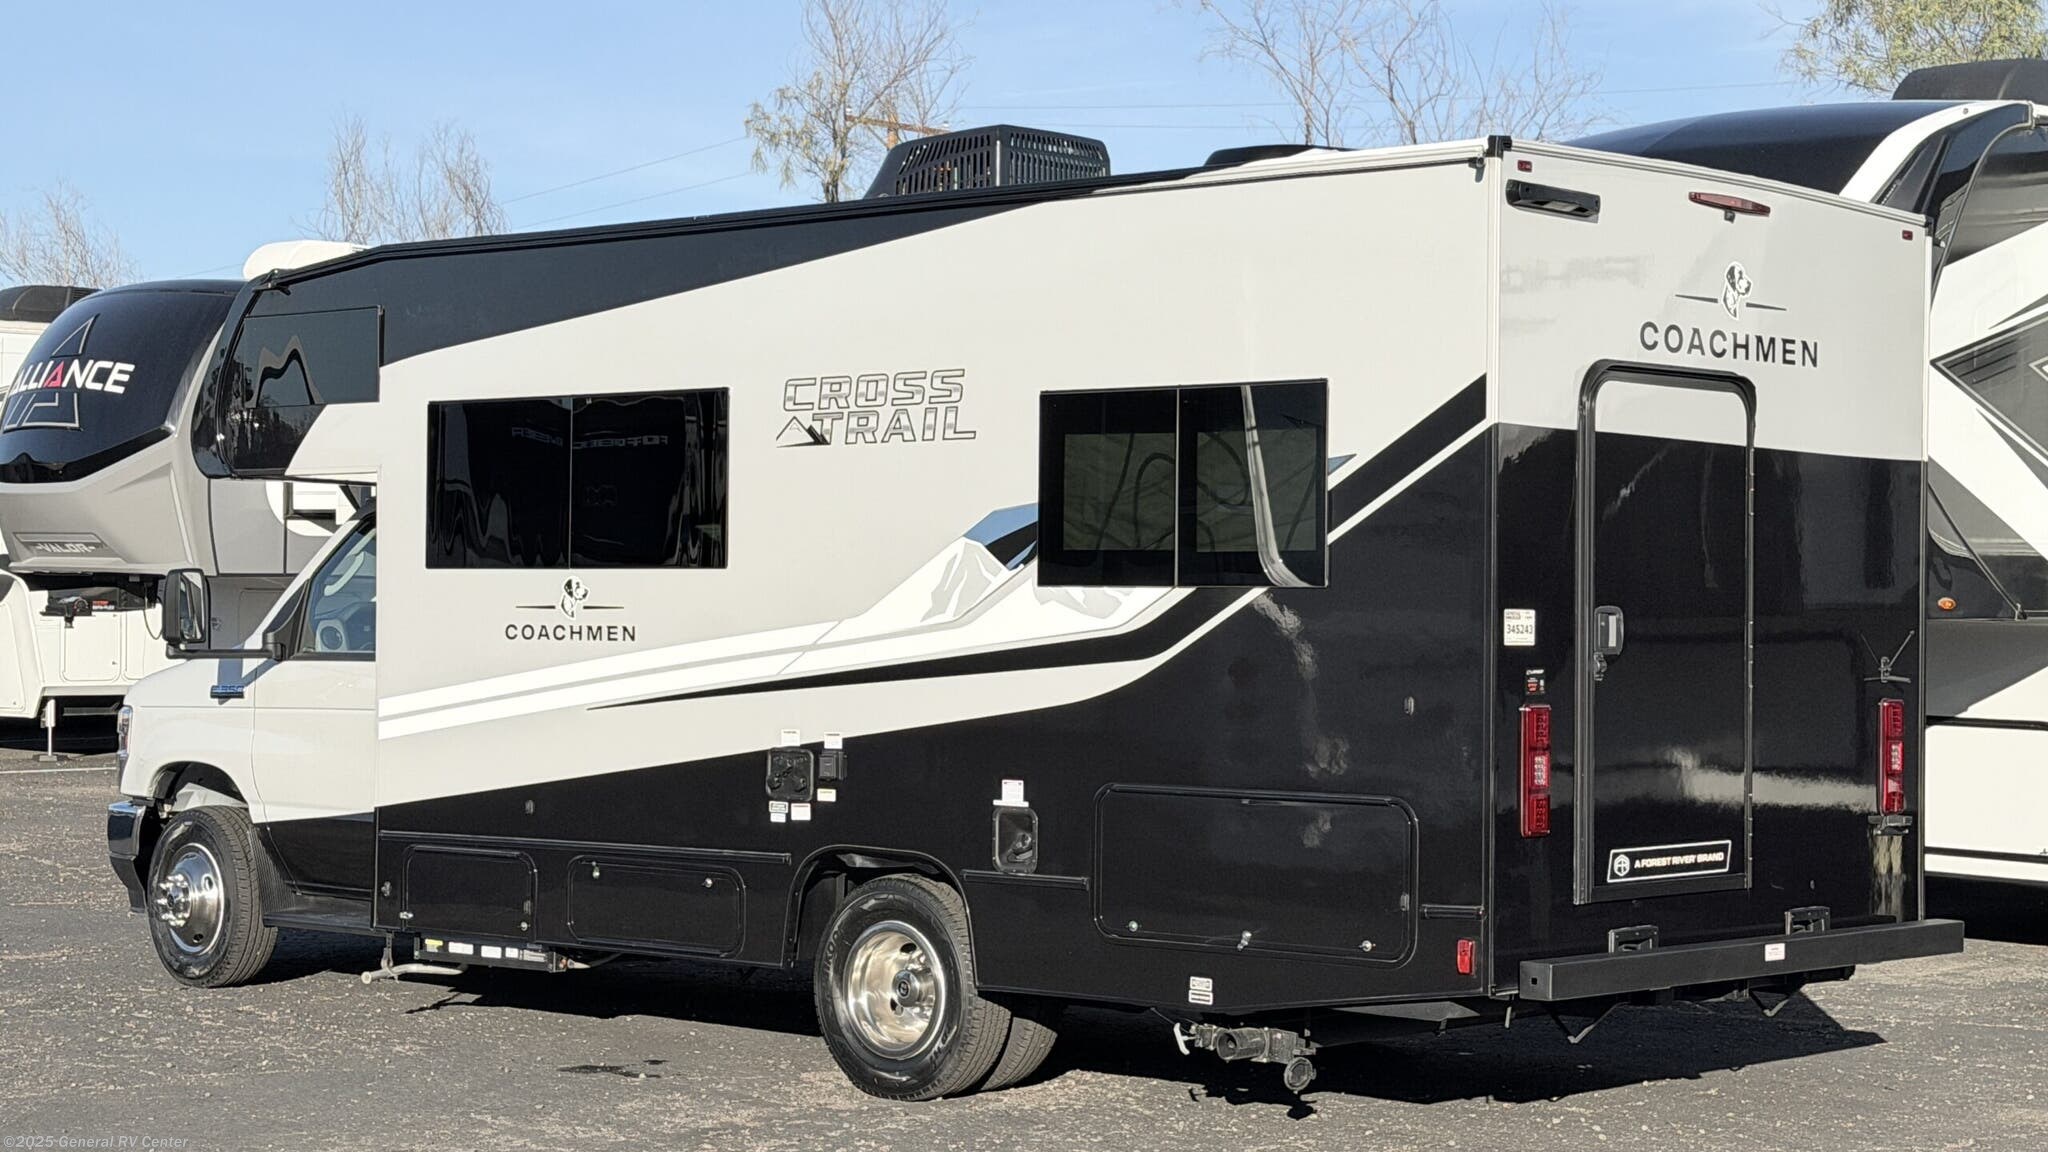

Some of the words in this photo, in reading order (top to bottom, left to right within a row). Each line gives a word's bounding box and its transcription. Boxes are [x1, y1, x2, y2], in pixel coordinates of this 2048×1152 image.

[1640, 321, 1818, 368] COACHMEN
[783, 368, 966, 412] CROSS
[811, 405, 977, 445] TRAIL
[504, 623, 636, 642] COACHMEN
[1506, 624, 1534, 635] 345243
[1633, 859, 1641, 869] A
[1641, 856, 1672, 868] FOREST
[1697, 852, 1725, 863] BRAND
